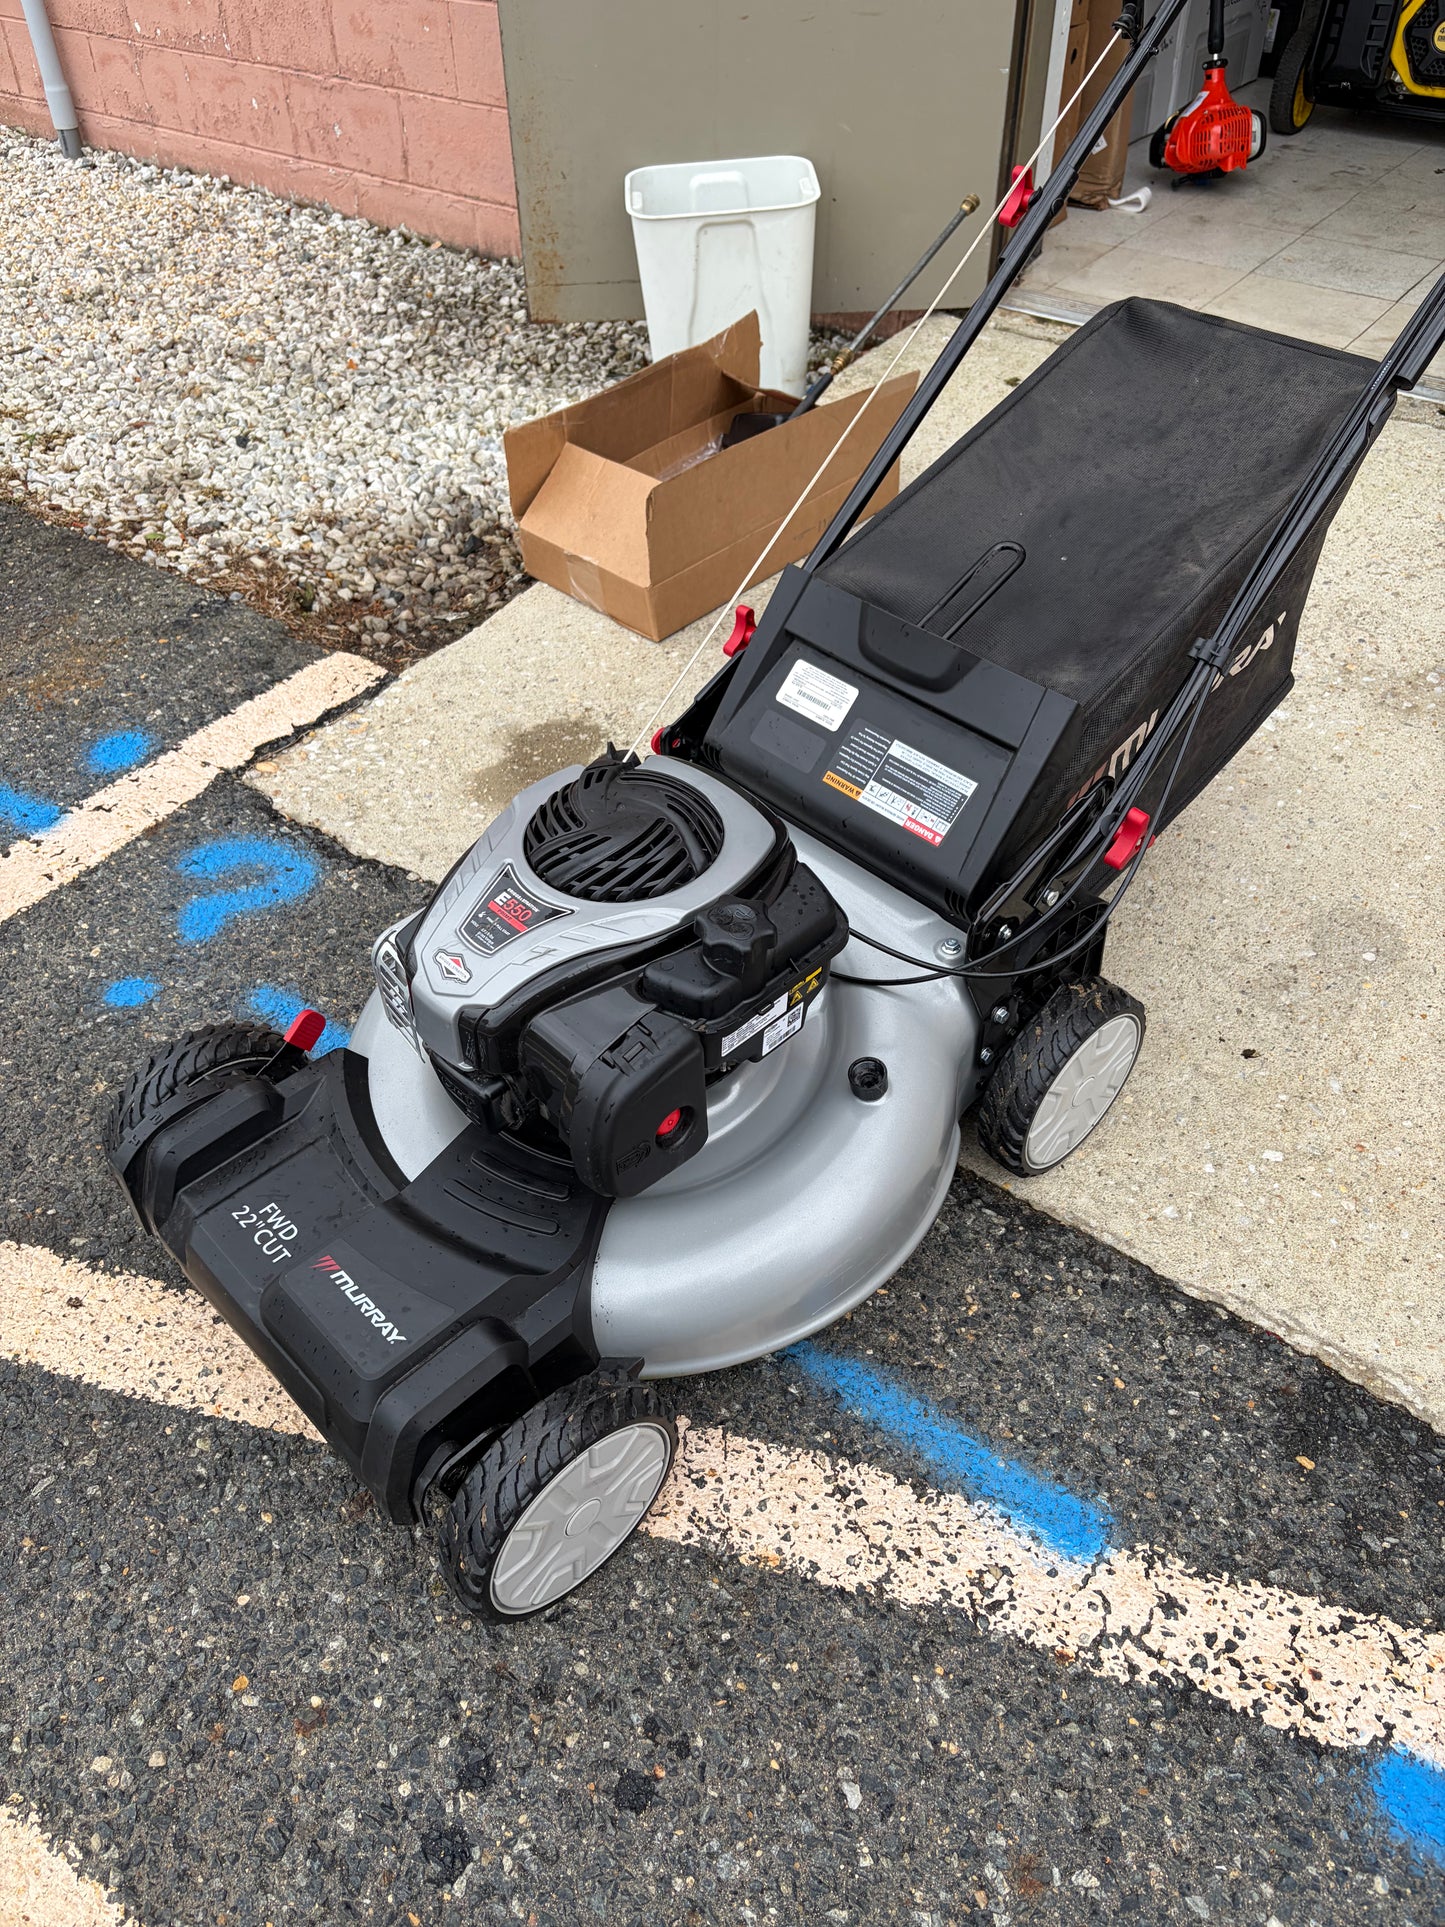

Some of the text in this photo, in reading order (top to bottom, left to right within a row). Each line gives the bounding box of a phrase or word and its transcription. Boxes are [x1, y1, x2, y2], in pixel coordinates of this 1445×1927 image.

[825, 773, 855, 794] WARNING
[905, 818, 933, 840] DANGER
[493, 891, 533, 922] E550
[496, 909, 512, 921] PRIME
[258, 1202, 299, 1242] FWD
